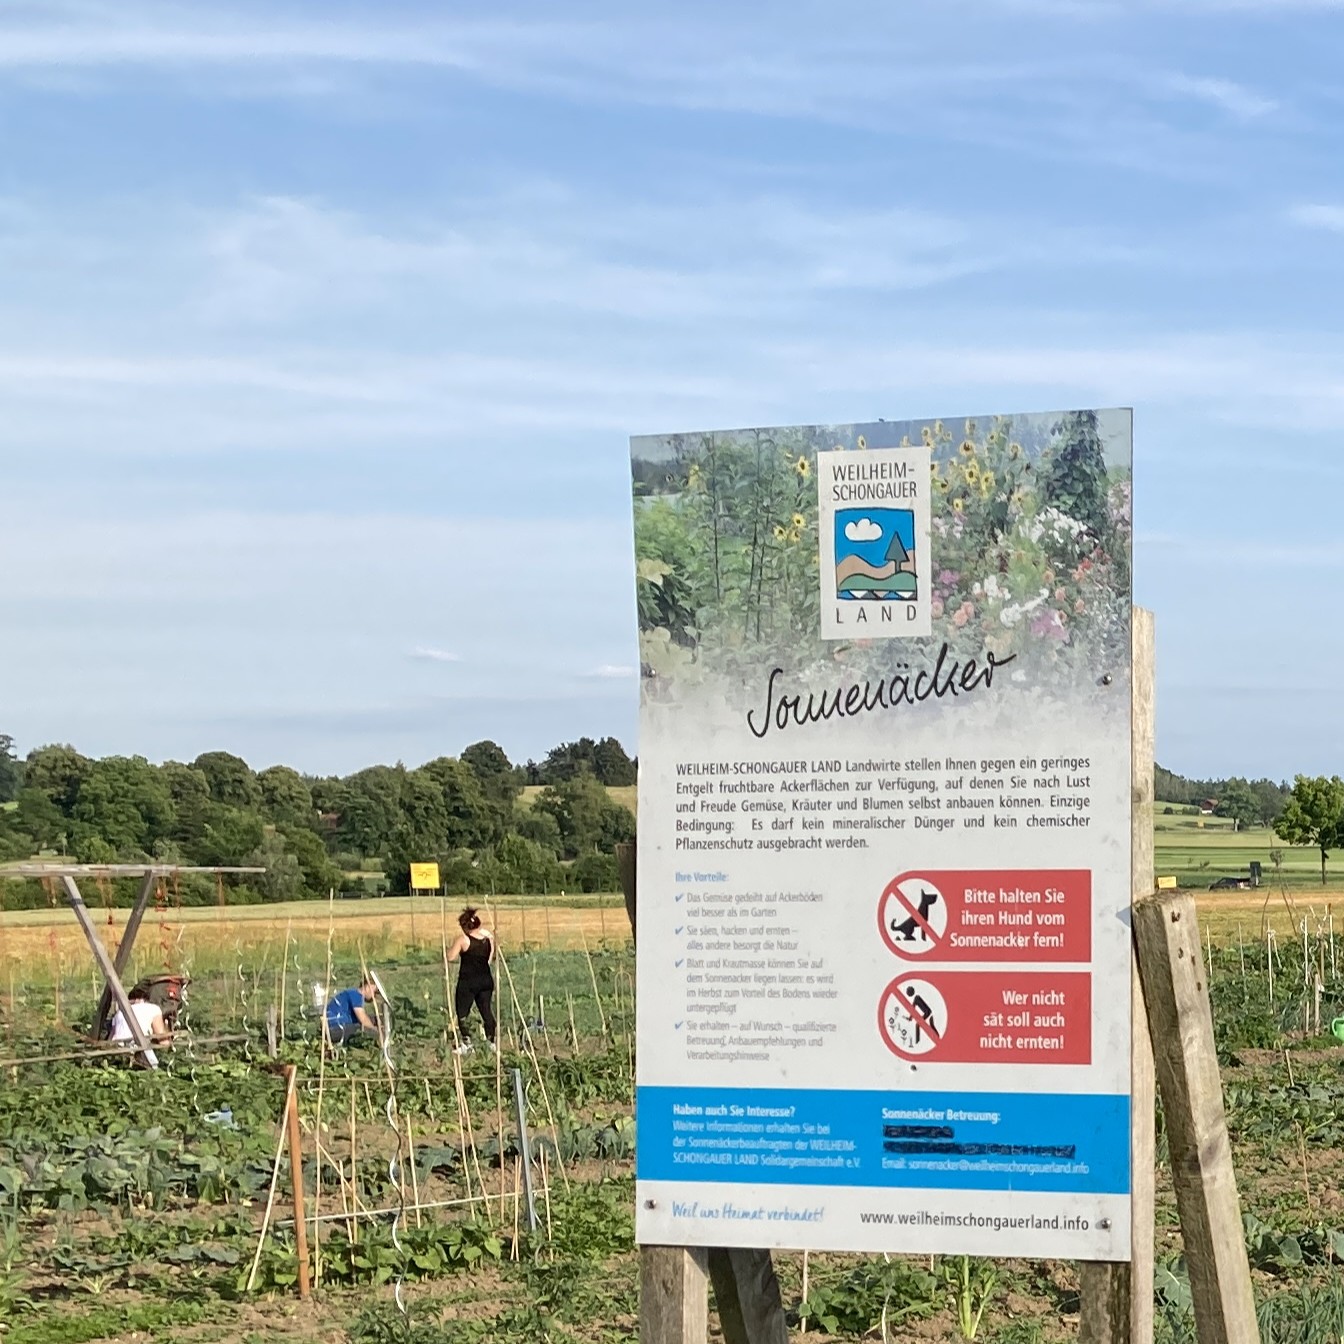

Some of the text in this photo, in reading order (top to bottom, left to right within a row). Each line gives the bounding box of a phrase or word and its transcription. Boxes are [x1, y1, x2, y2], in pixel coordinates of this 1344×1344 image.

[832, 462, 915, 482] WEILHEIM-
[832, 482, 917, 501] SCHONGAUER
[836, 605, 917, 624] LAND
[747, 643, 1017, 738] Sonnenäcker
[676, 755, 1090, 776] WEILHEIM-SCHONGAUER LAND Landwirte stellen Ihnen gegen ein geringes
[676, 775, 1090, 797] Entgelt fruchtbare Ackerflächen zur Verfügung, auf denen Sie nach Lust
[676, 794, 1090, 813] und Freude Gemüse, Kräuter und Blumen selbst anbauen können. Einzige
[676, 814, 1090, 834] Bedingung: Es darf kein mineralischer Dünger und kein chemischer
[676, 836, 869, 852] Pflanzenschutz ausgebracht werden.
[675, 872, 729, 882] Ihre Vorteile:
[687, 892, 823, 905] Das Gemüse gedeiht auf Ackerböden
[964, 889, 1065, 904] Bitte halten Sie
[687, 907, 777, 917] viel besser als im Garten
[961, 911, 1065, 926] ihren Hund vom
[687, 925, 698, 935] Sie
[700, 925, 719, 936] säen,
[721, 925, 747, 935] hacken
[749, 925, 763, 935] und
[766, 926, 790, 935] ernten
[687, 940, 798, 952] alles andere besorgt die Natur
[950, 932, 1064, 948] Sonnenacker fern!
[687, 958, 823, 968] Blatt und Krautmasse können Sie auf
[687, 989, 696, 998] im
[698, 988, 722, 998] Herbst
[741, 988, 765, 998] Vorteil
[768, 989, 780, 998] des
[782, 989, 811, 998] Bodens
[812, 989, 838, 998] wieder
[1002, 991, 1065, 1006] Wer nicht
[984, 1012, 1065, 1027] sät soll auch
[980, 1034, 1064, 1049] nicht ernten!
[673, 1104, 796, 1117] Haben auch Sie Interesse?
[882, 1108, 1001, 1124] Sonnenäcker Betreuung:
[672, 1201, 824, 1222] Weil uns Heimat verbindet!
[861, 1211, 1089, 1231] www.weilheimschongauerland.info
